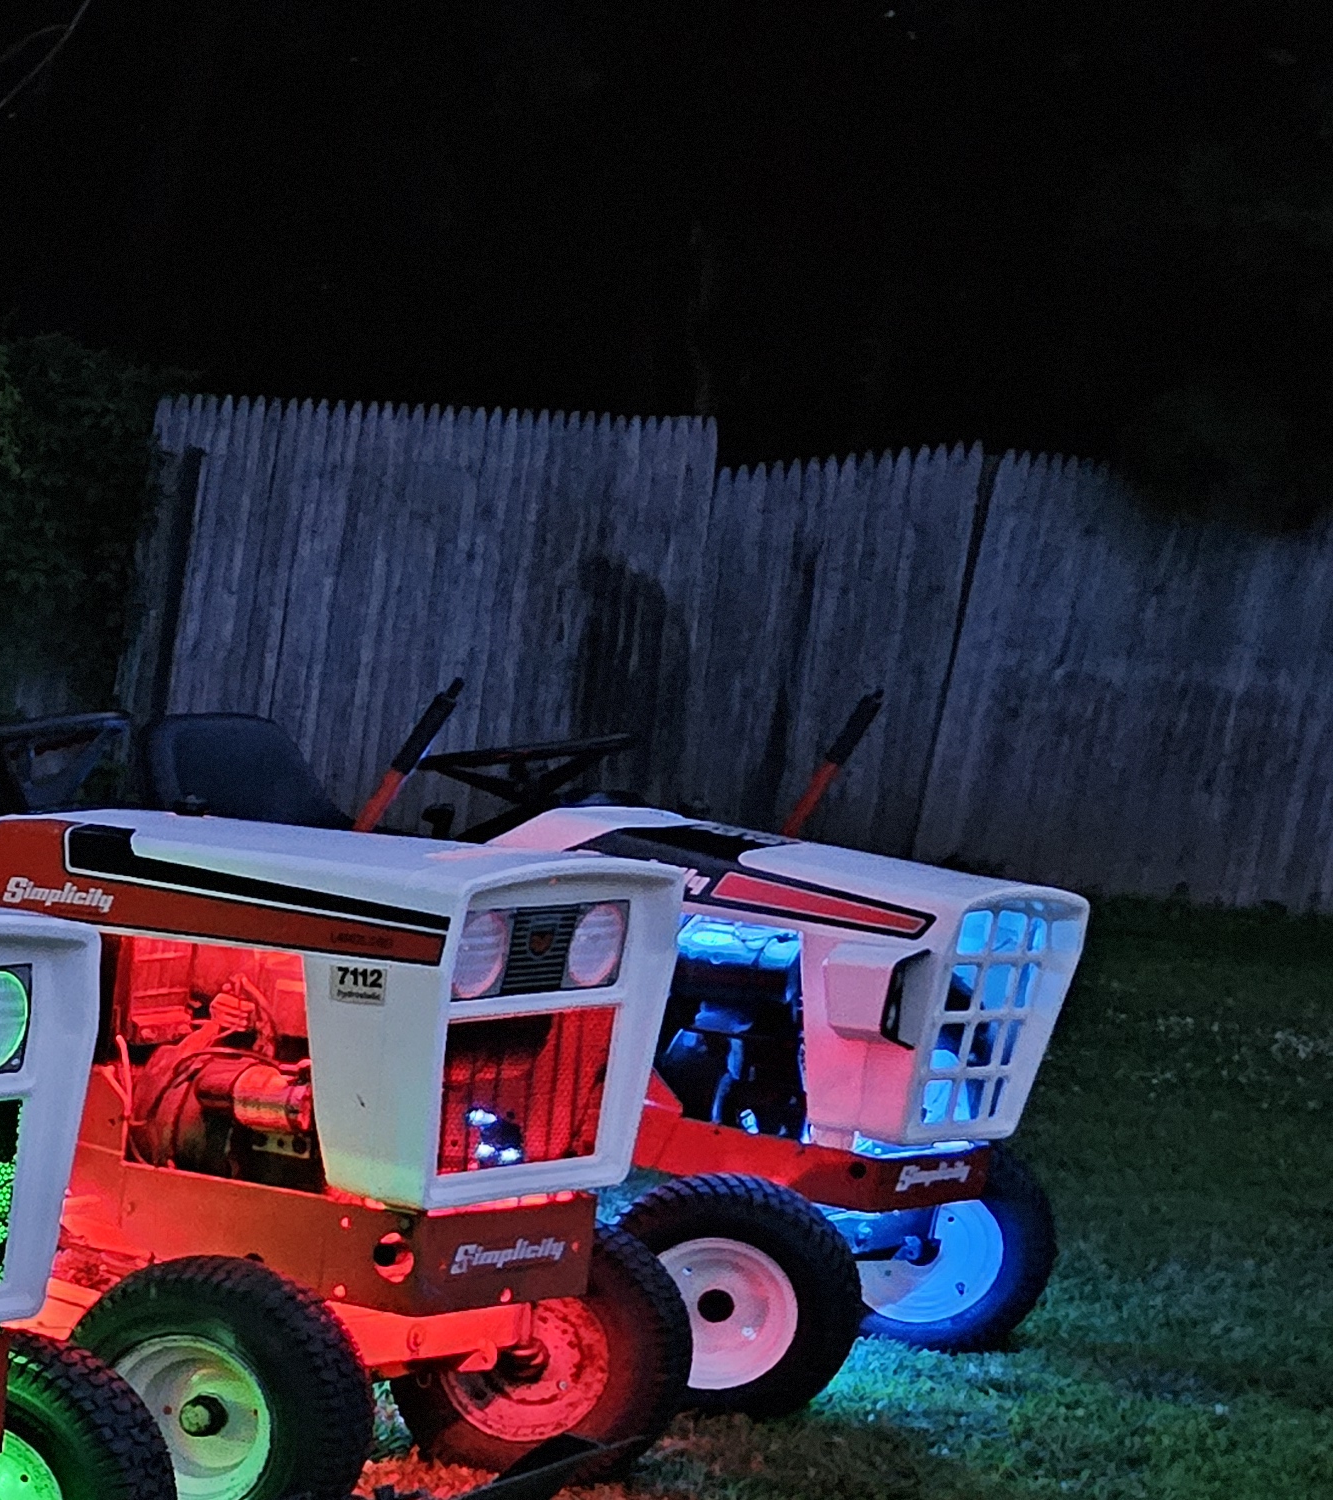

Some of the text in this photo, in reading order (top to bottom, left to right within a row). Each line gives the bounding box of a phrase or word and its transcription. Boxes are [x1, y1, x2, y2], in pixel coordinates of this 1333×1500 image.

[2, 876, 114, 913] Simplicity
[337, 966, 383, 988] 7112
[450, 1237, 565, 1275] Simplicity
